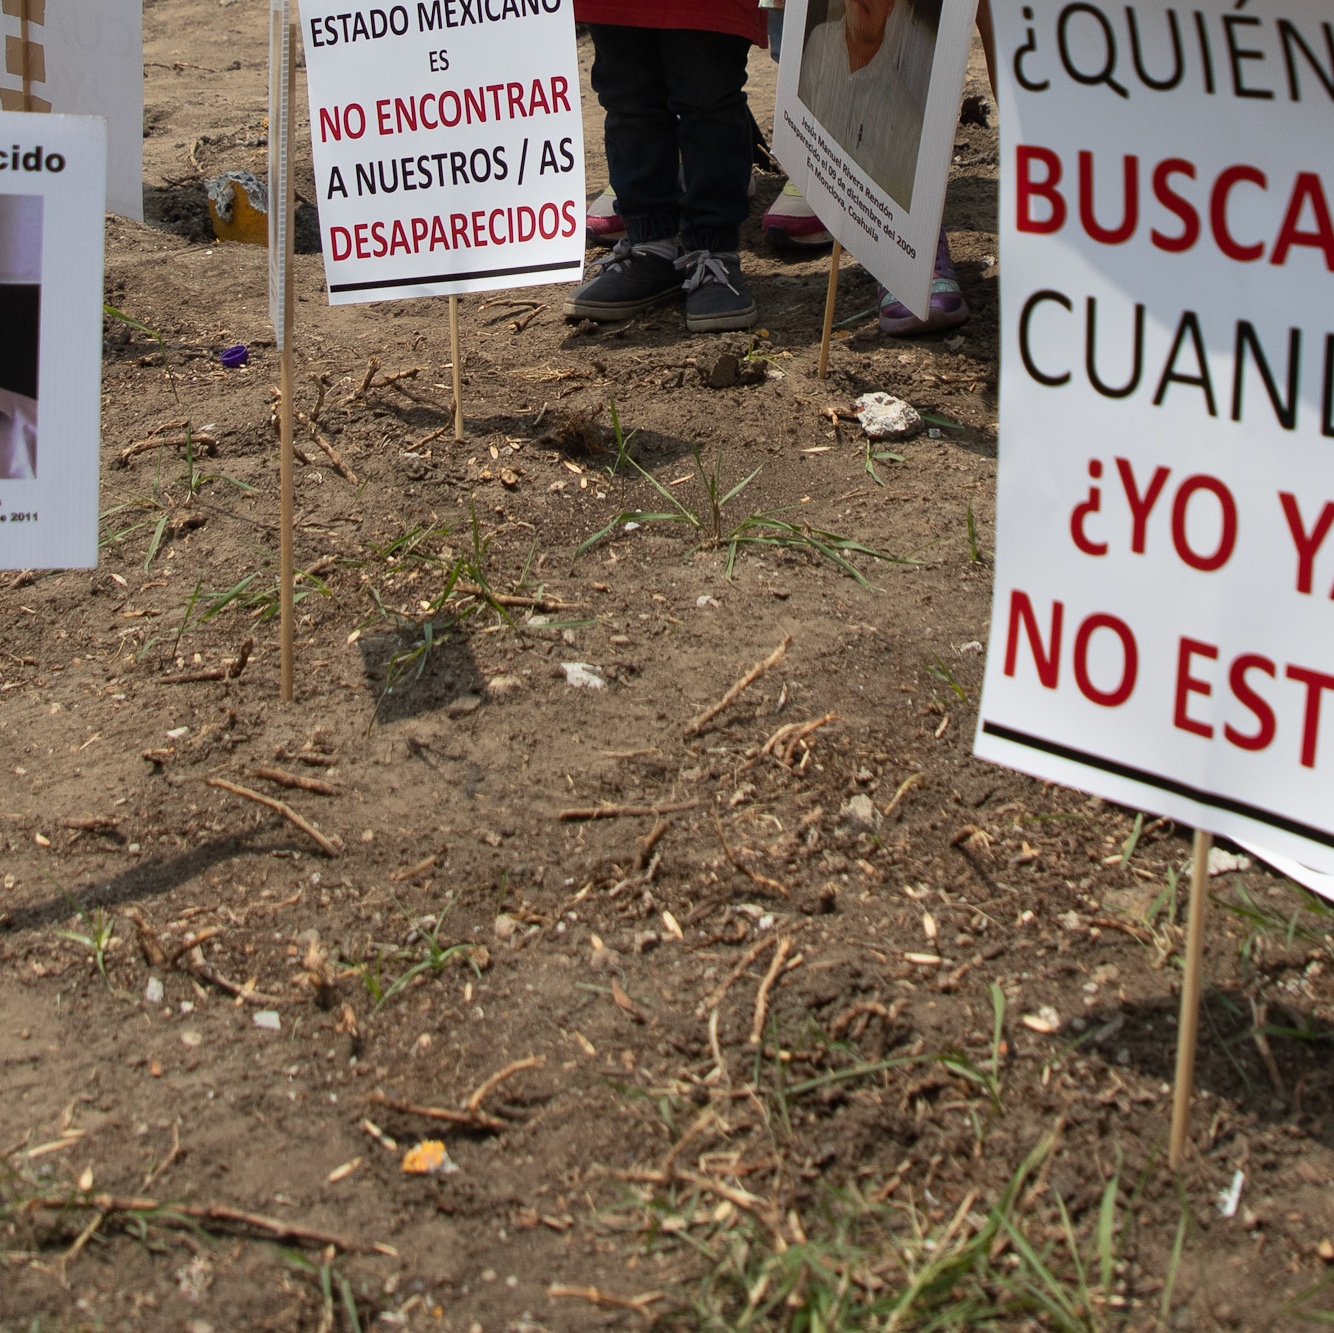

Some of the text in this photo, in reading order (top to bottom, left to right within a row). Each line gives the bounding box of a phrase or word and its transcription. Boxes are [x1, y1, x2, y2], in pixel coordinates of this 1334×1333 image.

[310, 5, 409, 48] ESTADO
[429, 50, 449, 73] ES
[319, 76, 571, 143] NO ENCONTRAR
[327, 137, 575, 200] A NUESTROS AS
[784, 110, 916, 259] Desaparecido el 09 de diciembre del 2009
[802, 116, 893, 221] Jesús Manuel Rivera Rendón
[807, 156, 879, 242] En Monclova, Coahuila
[330, 200, 577, 262] DESAPARECIDOS
[10, 512, 38, 521] 2011
[1070, 456, 1238, 573] ¿YO
[1003, 588, 1139, 708] NO
